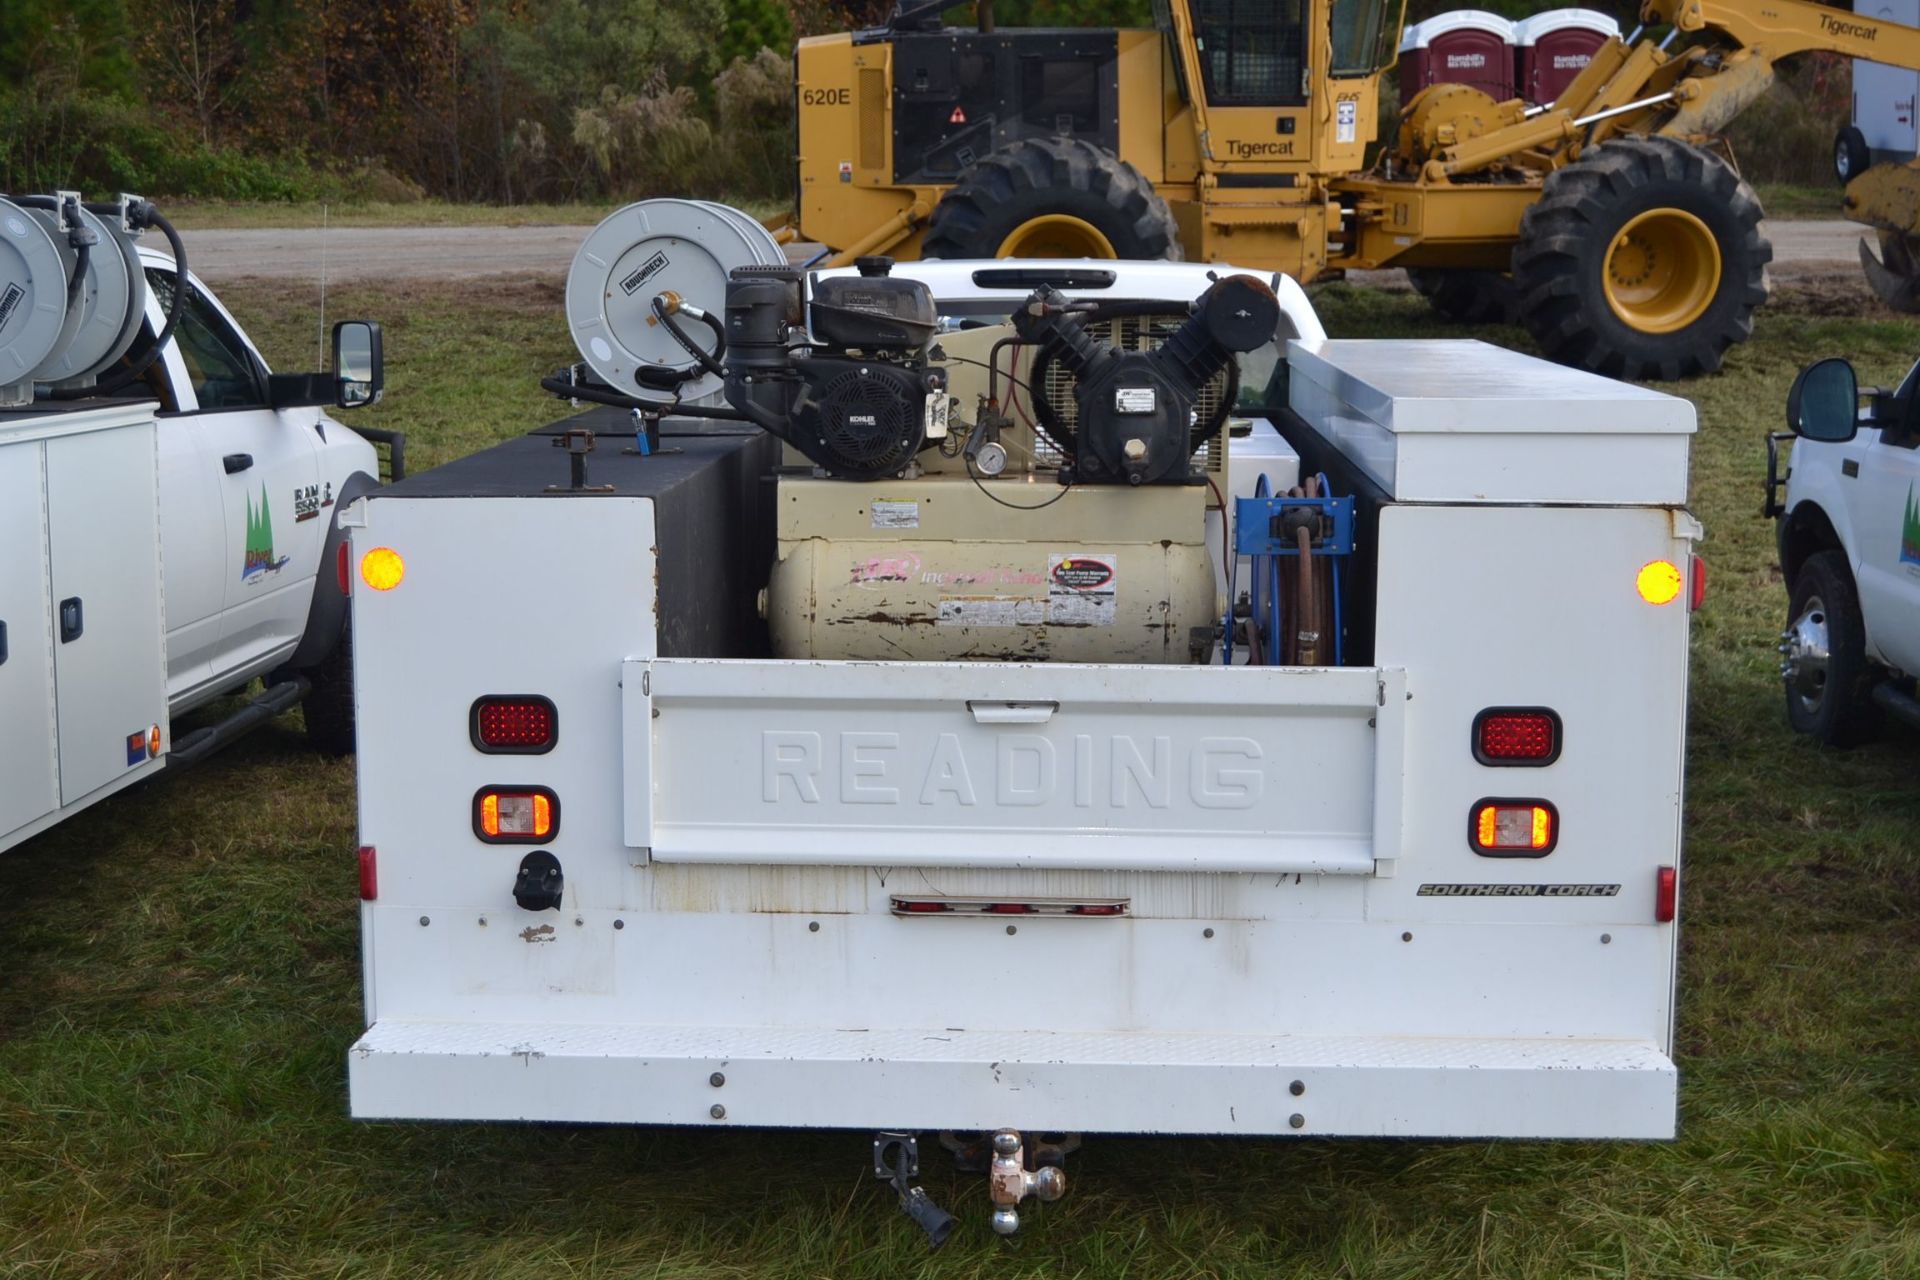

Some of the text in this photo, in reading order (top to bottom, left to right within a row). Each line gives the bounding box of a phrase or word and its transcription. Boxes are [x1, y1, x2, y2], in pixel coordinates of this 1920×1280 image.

[1820, 13, 1878, 41] Tigercat
[803, 88, 851, 105] 620E
[1226, 140, 1294, 158] Tigercat
[624, 256, 665, 291] ROUGHNECK
[849, 415, 875, 423] KOHLER
[294, 484, 319, 501] RAM
[761, 730, 1264, 810] READING
[1418, 884, 1621, 896] SOUTHERN COACH
